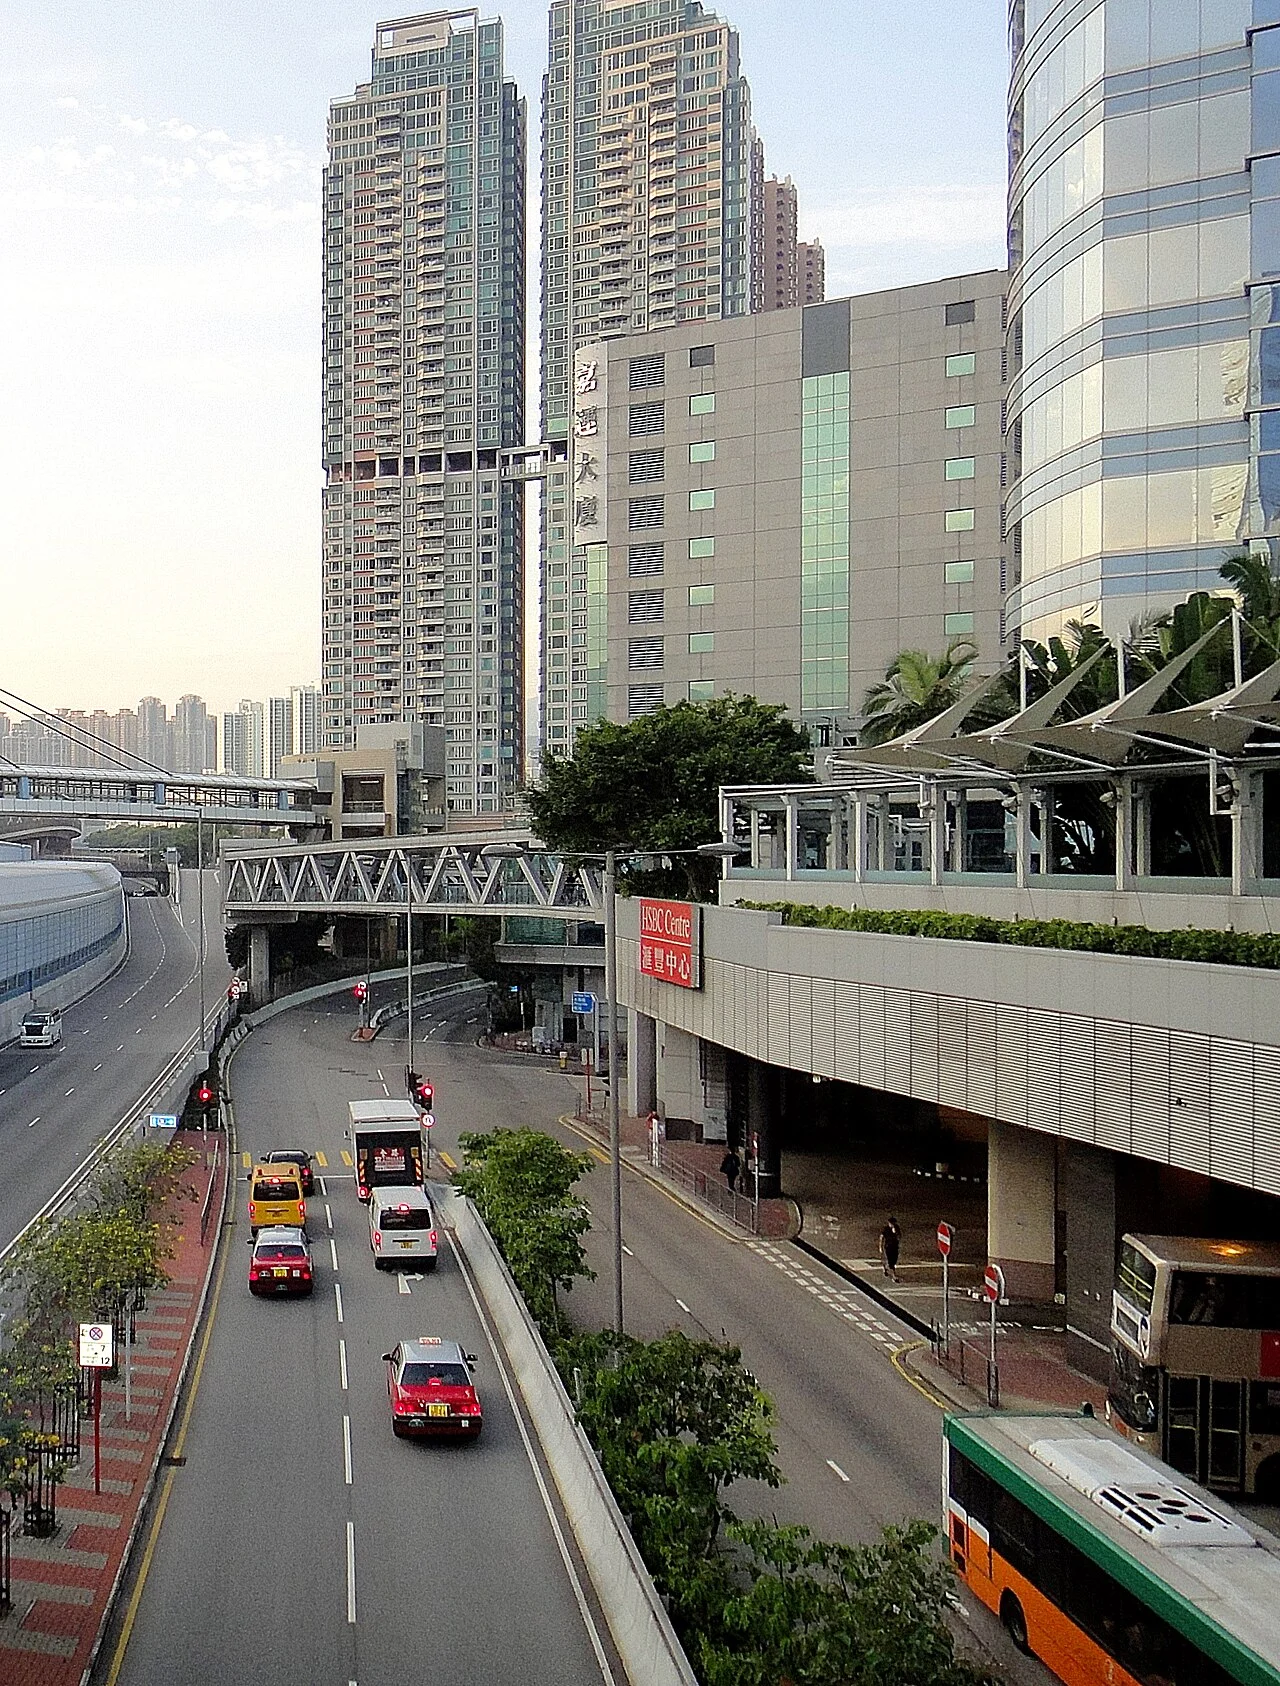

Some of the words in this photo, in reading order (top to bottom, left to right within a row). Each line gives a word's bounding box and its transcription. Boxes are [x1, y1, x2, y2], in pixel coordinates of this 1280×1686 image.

[642, 906, 664, 933] HSBC
[665, 909, 690, 938] Centre
[100, 1344, 106, 1352] 7
[101, 1357, 110, 1365] 12
